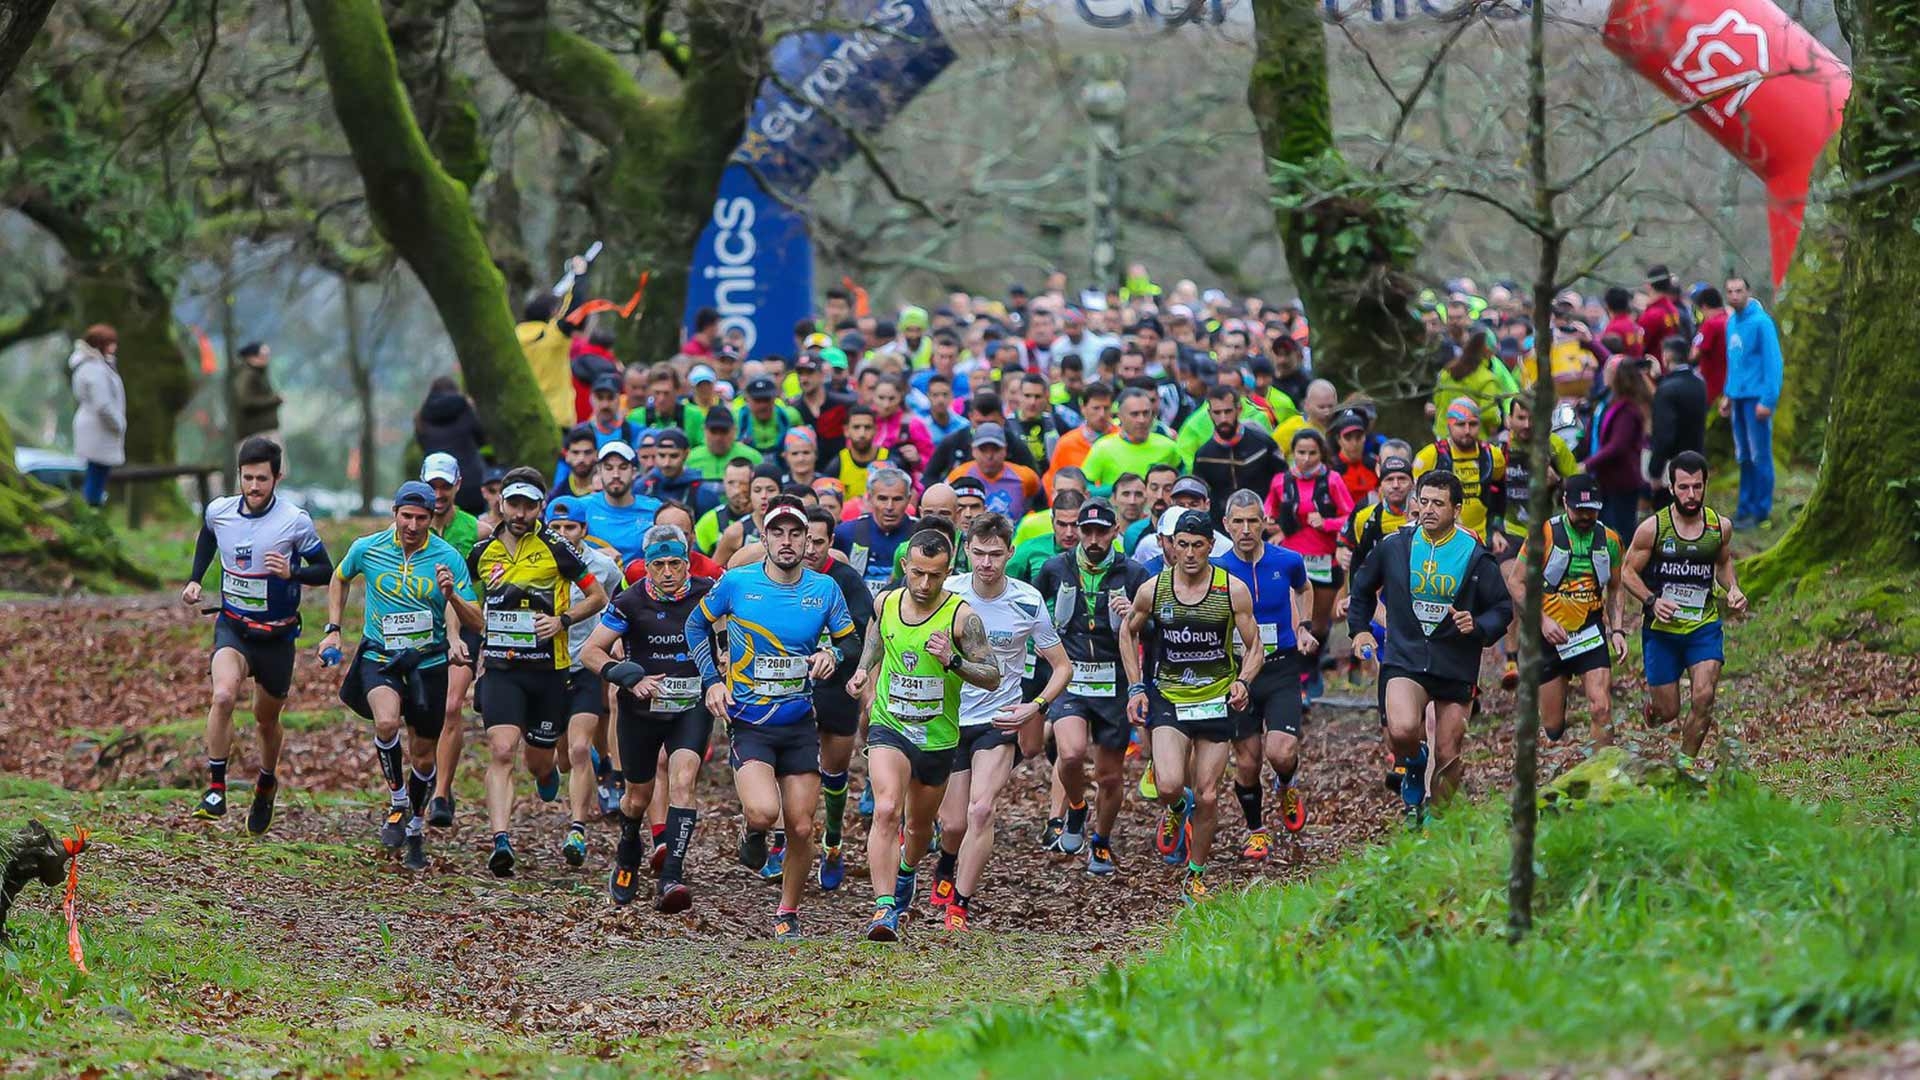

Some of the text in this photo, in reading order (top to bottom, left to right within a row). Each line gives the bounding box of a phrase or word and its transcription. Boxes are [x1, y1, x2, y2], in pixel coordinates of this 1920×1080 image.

[394, 614, 416, 624] 2555
[500, 613, 518, 623] 2179
[667, 680, 687, 690] 2168
[901, 678, 923, 690] 2341
[673, 816, 694, 858] Kalenji
